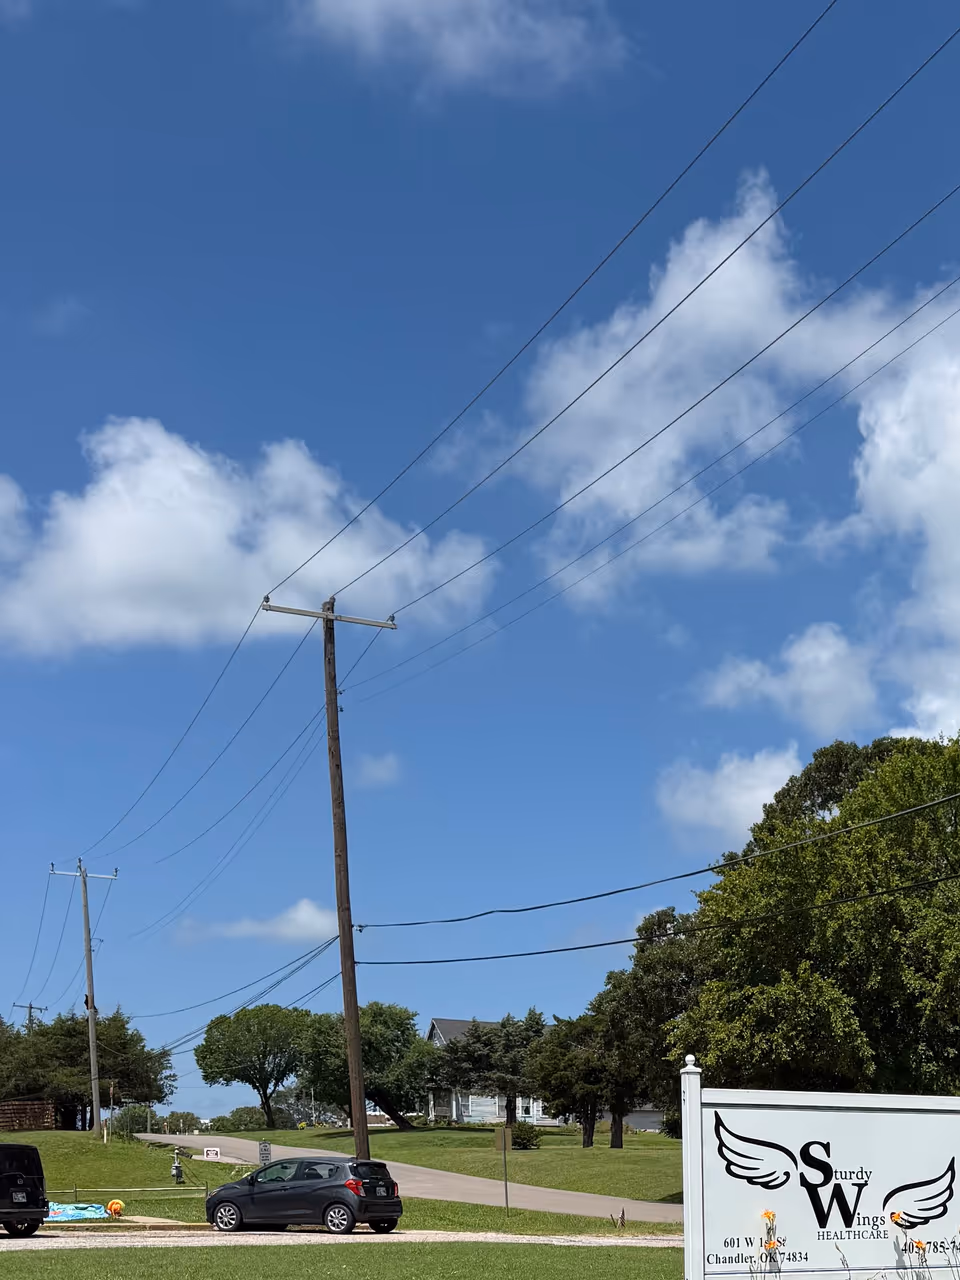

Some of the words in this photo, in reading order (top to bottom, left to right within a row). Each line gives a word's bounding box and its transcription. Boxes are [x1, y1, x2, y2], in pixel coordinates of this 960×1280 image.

[799, 1140, 873, 1188] Sturdy
[800, 1182, 886, 1231] Wings
[817, 1229, 889, 1240] HEALTHCARE
[723, 1237, 740, 1249] 601
[744, 1236, 755, 1248] W
[760, 1236, 775, 1248] 1s
[706, 1253, 757, 1265] Chandler,
[760, 1251, 778, 1264] OK
[780, 1251, 809, 1263] 74834
